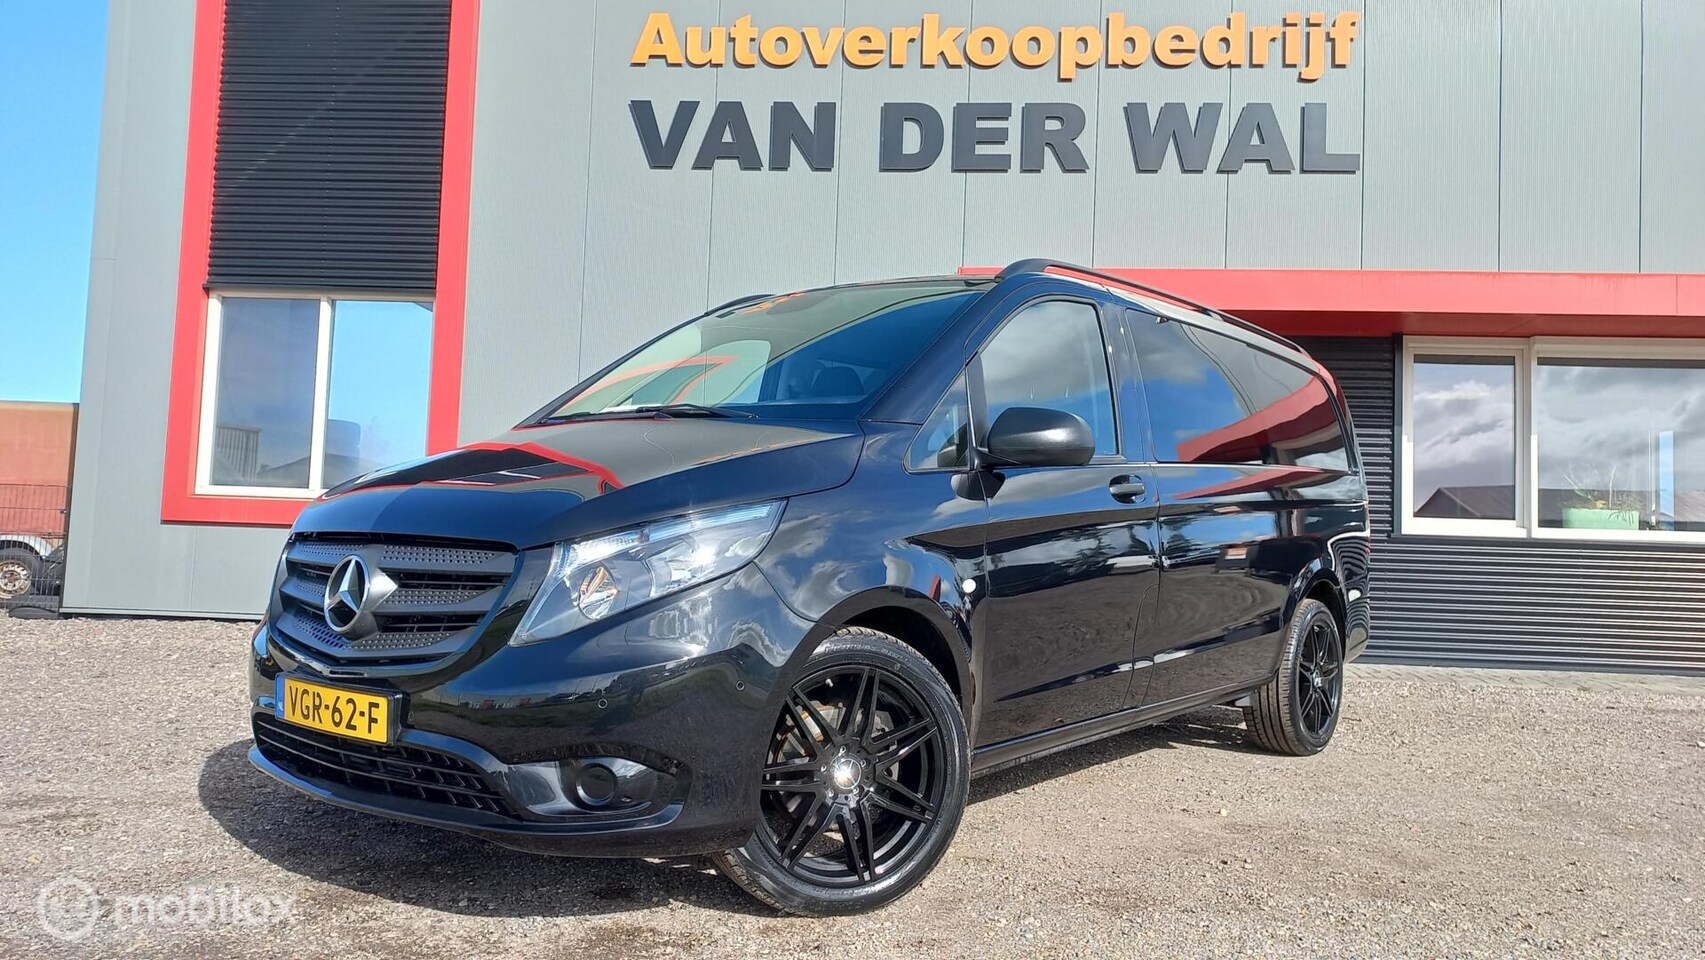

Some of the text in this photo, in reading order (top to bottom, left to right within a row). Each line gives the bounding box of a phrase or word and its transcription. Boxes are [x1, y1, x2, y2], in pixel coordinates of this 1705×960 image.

[630, 12, 1361, 82] Autoverkoopbedrijf
[629, 100, 1361, 174] VAN DER WAL
[288, 685, 380, 734] VGR-62-F
